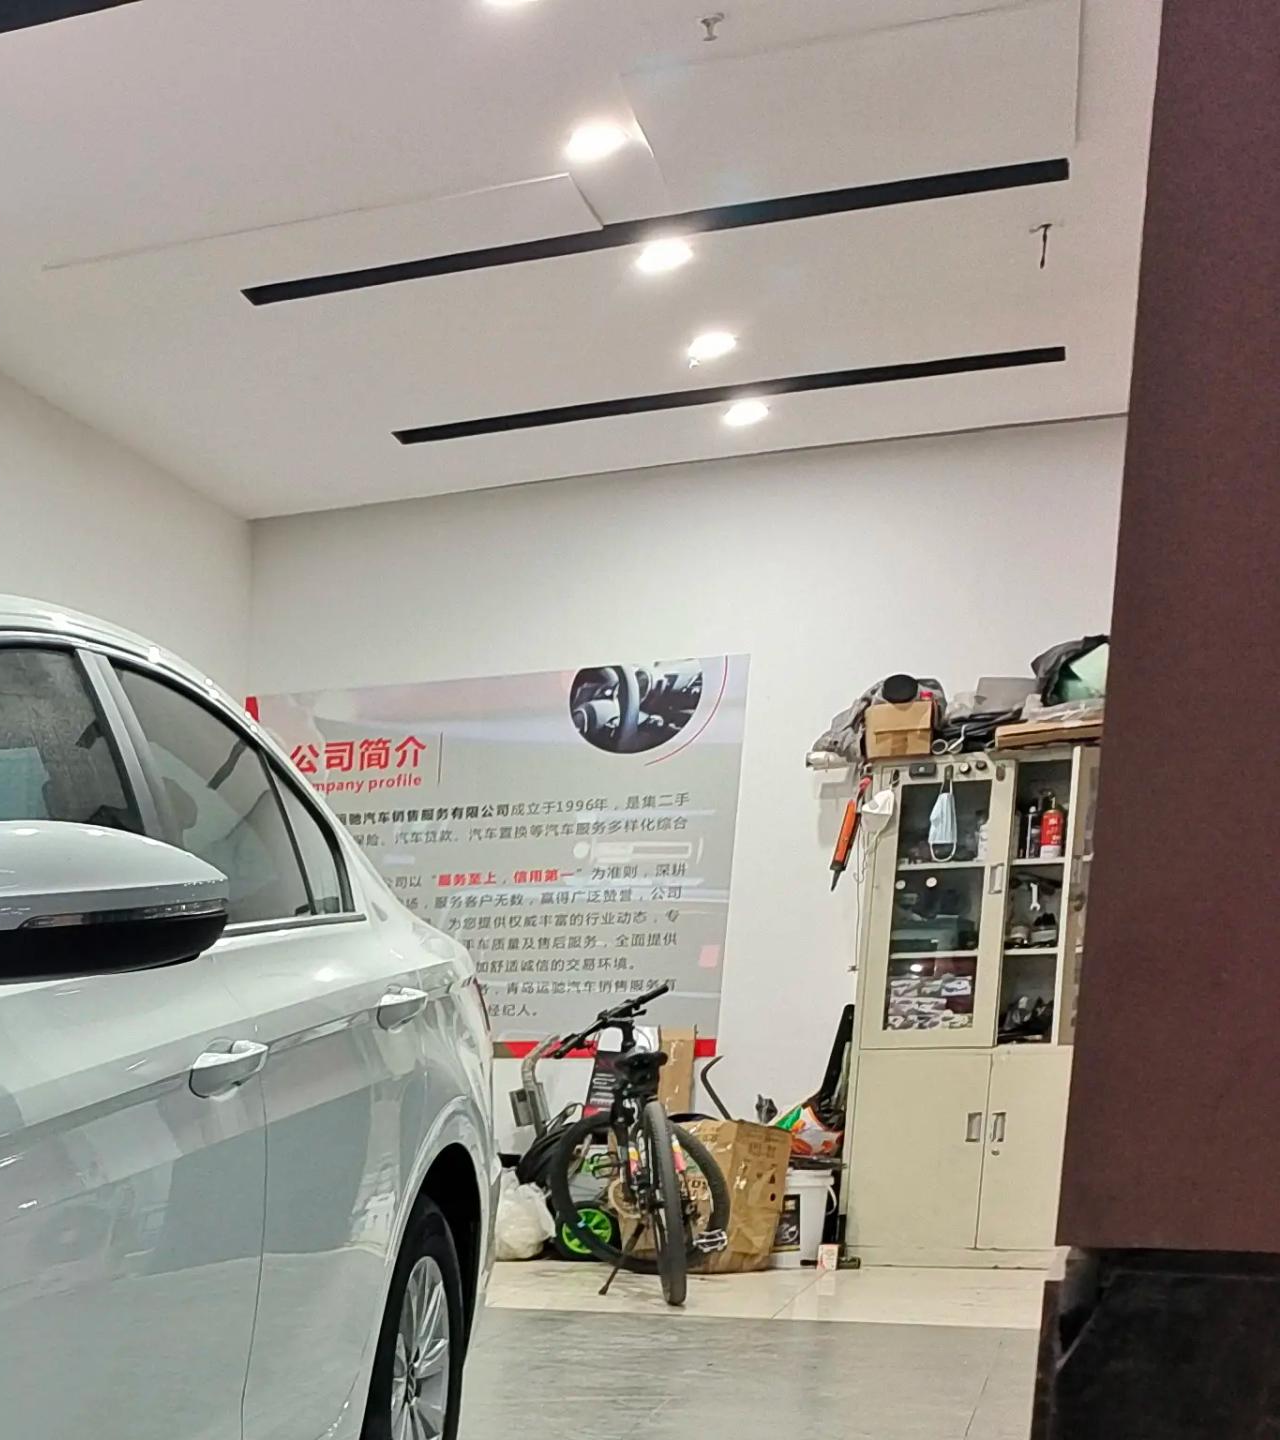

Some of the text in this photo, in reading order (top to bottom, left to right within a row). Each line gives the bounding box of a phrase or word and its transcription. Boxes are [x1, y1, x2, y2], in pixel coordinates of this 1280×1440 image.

[289, 735, 427, 774] 公司简介
[368, 773, 423, 793] profile
[403, 885, 684, 911] 场，服务客户无数，赢得广泛赞誉，公司
